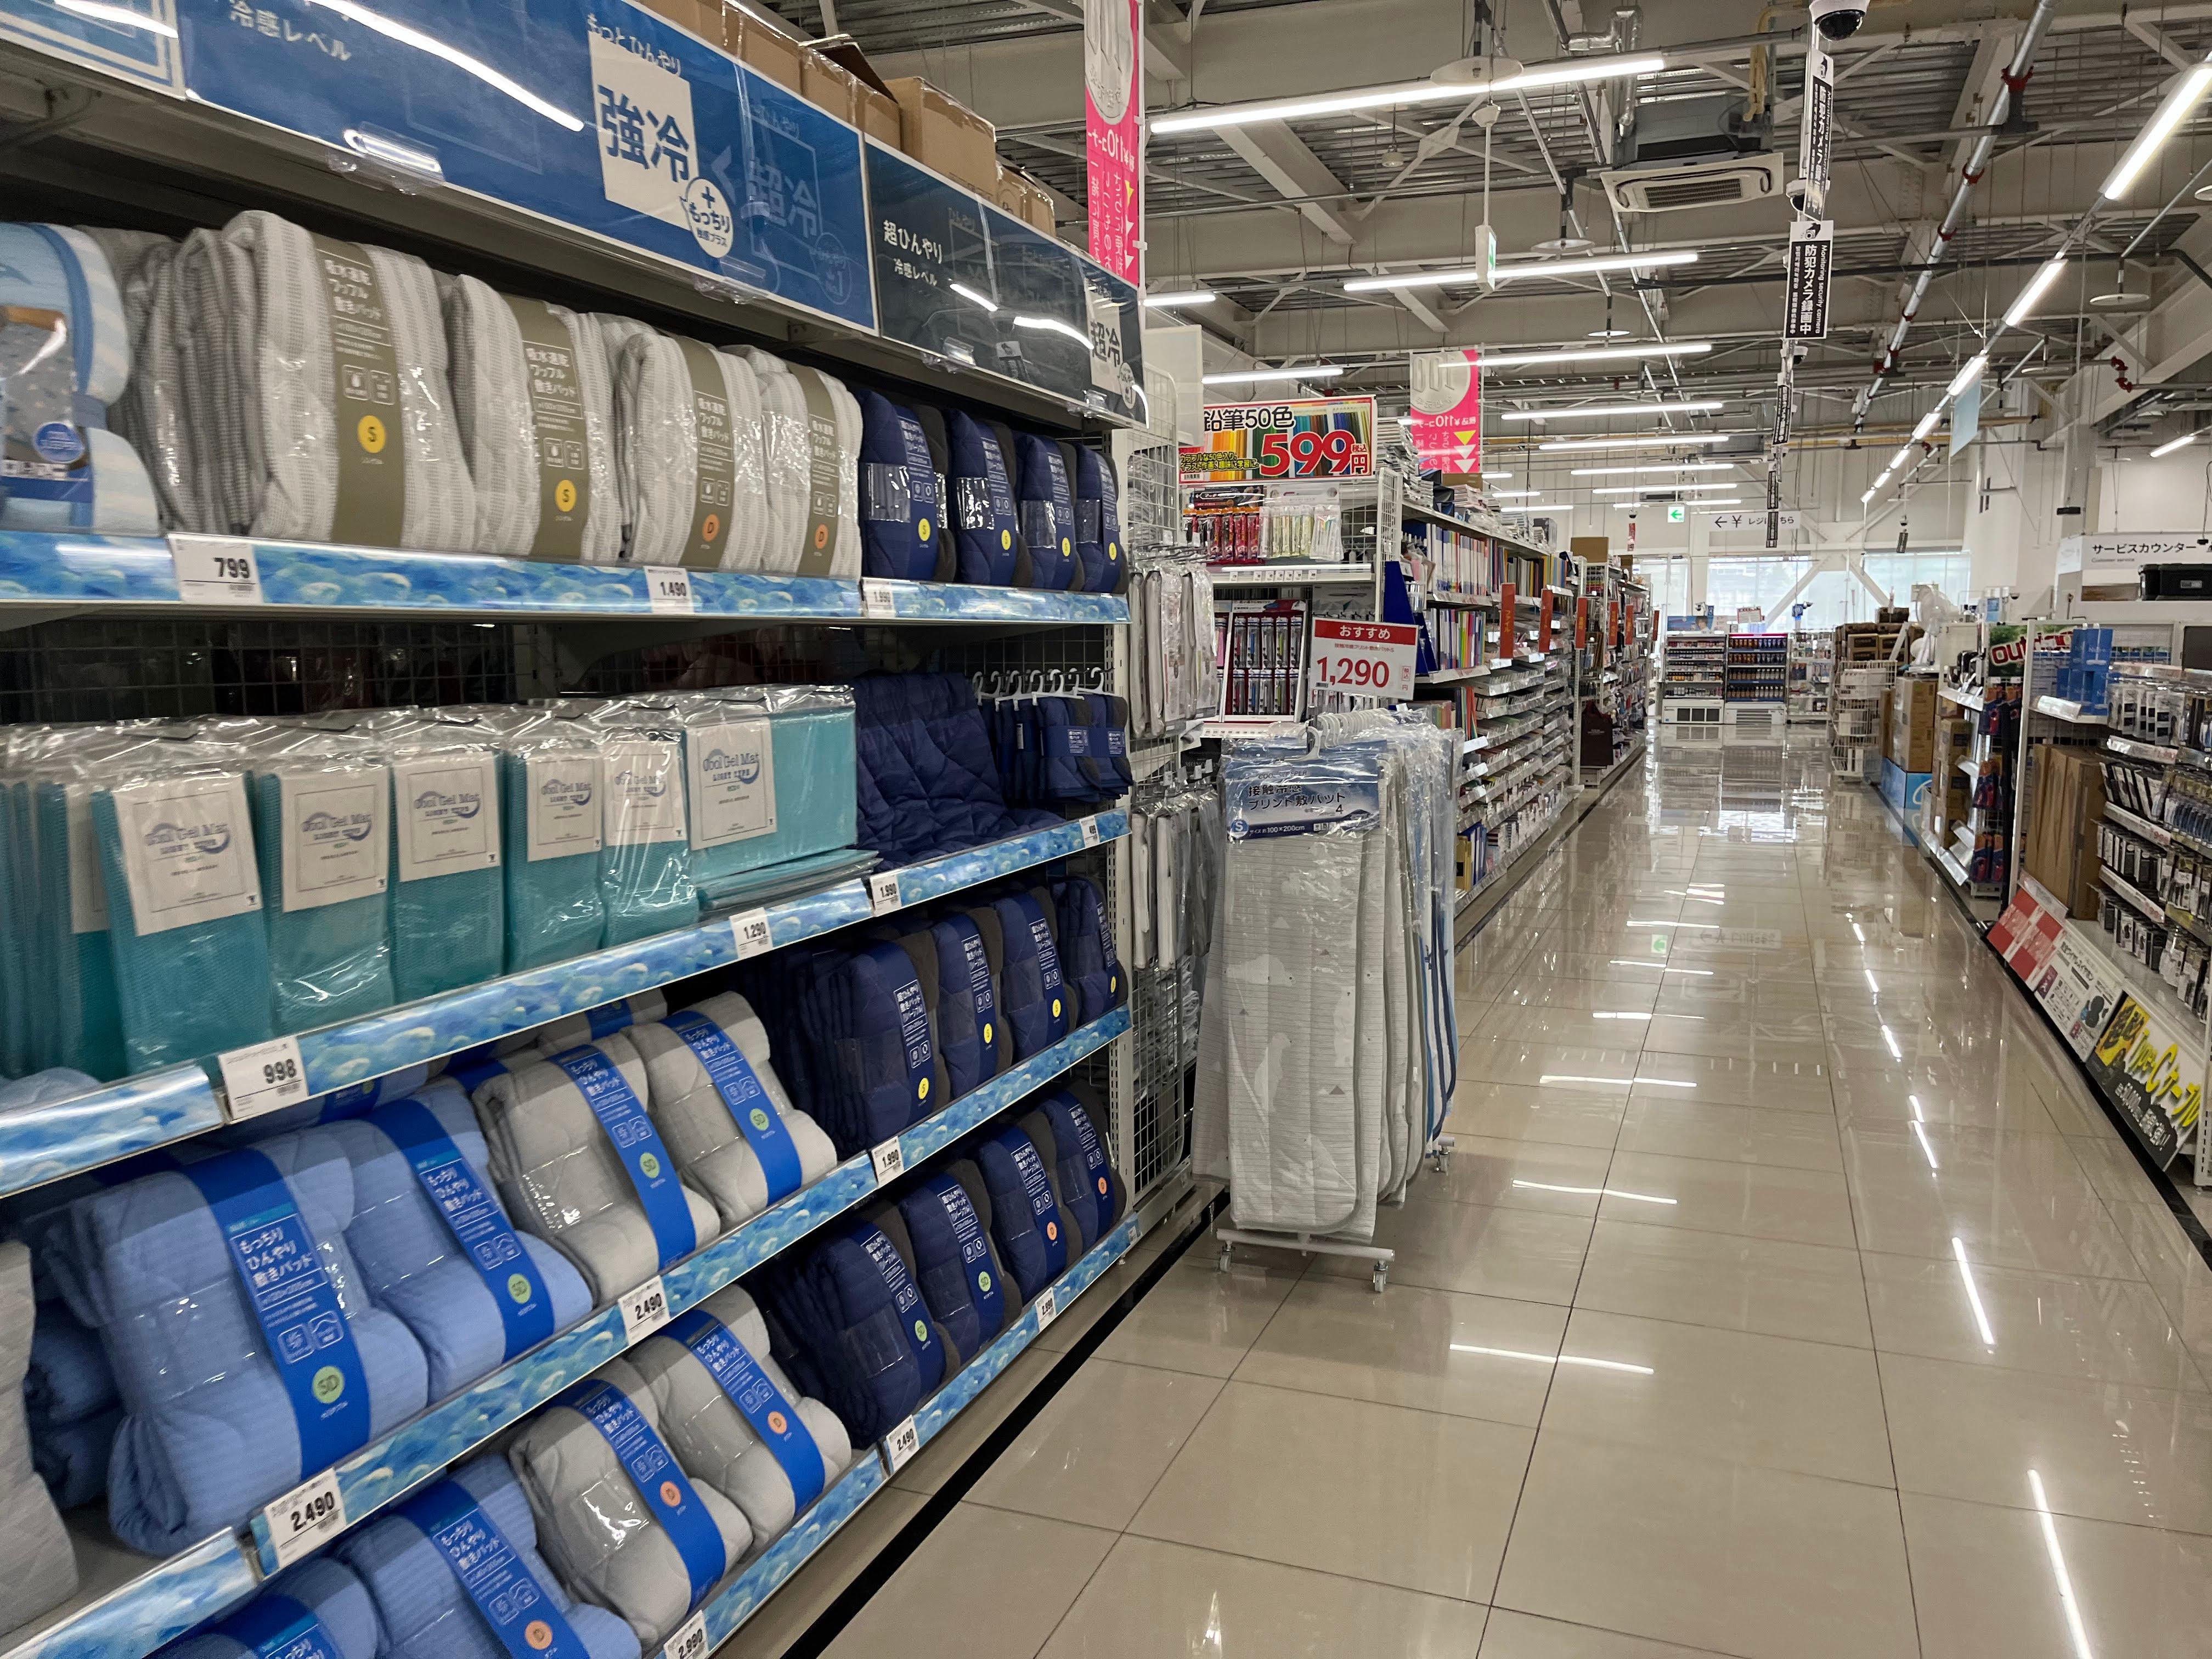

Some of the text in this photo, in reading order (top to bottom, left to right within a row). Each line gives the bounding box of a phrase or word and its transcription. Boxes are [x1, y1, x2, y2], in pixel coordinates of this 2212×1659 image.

[230, 0, 352, 61] 冷感レベル
[597, 84, 690, 182] 強冷
[690, 202, 730, 233] もっちり
[883, 219, 943, 264] 超ひんやり
[893, 257, 937, 286] 冷感レベル
[1818, 244, 1827, 281] Monitoring
[1799, 244, 1818, 335] 防犯カメラ録画中
[1204, 406, 1295, 432] 鉛筆50色
[1260, 430, 1356, 476] 599
[1351, 453, 1368, 475] 円
[1748, 516, 1795, 525] レジちら
[2092, 543, 2197, 554] サービスカウンター
[214, 557, 250, 579] 799
[1339, 625, 1391, 640] おすすめ
[1317, 657, 1390, 688] 1,290
[1248, 785, 1302, 797] 接触冷感
[1335, 804, 1345, 814] 4
[1235, 821, 1244, 832] S
[263, 1058, 297, 1084] 998
[239, 1227, 285, 1254] もっちり
[246, 1240, 298, 1269] ひんやり
[252, 1252, 313, 1286] 敷きパッド
